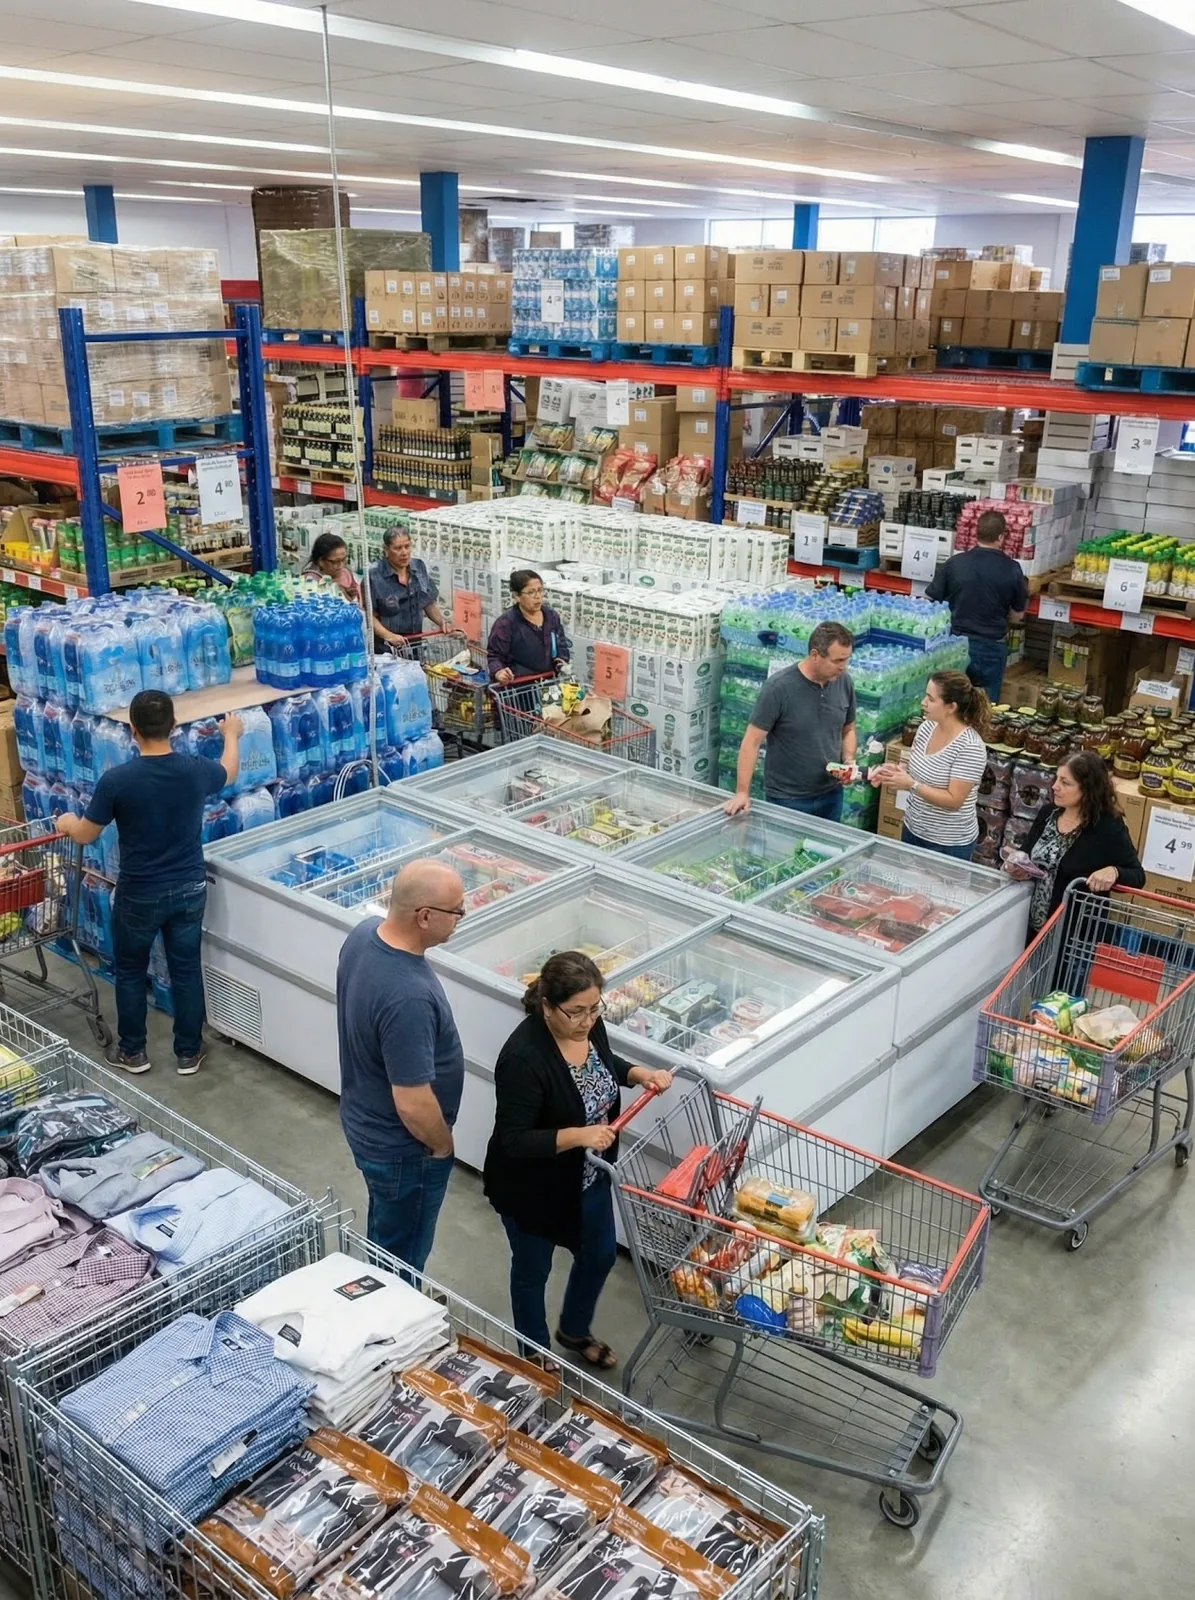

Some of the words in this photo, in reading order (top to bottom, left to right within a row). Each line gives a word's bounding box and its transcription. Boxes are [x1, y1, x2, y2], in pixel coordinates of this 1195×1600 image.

[1130, 438, 1140, 451] 3
[214, 481, 223, 496] 4
[136, 491, 145, 506] 2
[913, 549, 920, 562] 4
[1120, 581, 1129, 593] 6
[605, 666, 612, 680] 5
[1164, 838, 1177, 854] 4
[1180, 840, 1193, 850] 99
